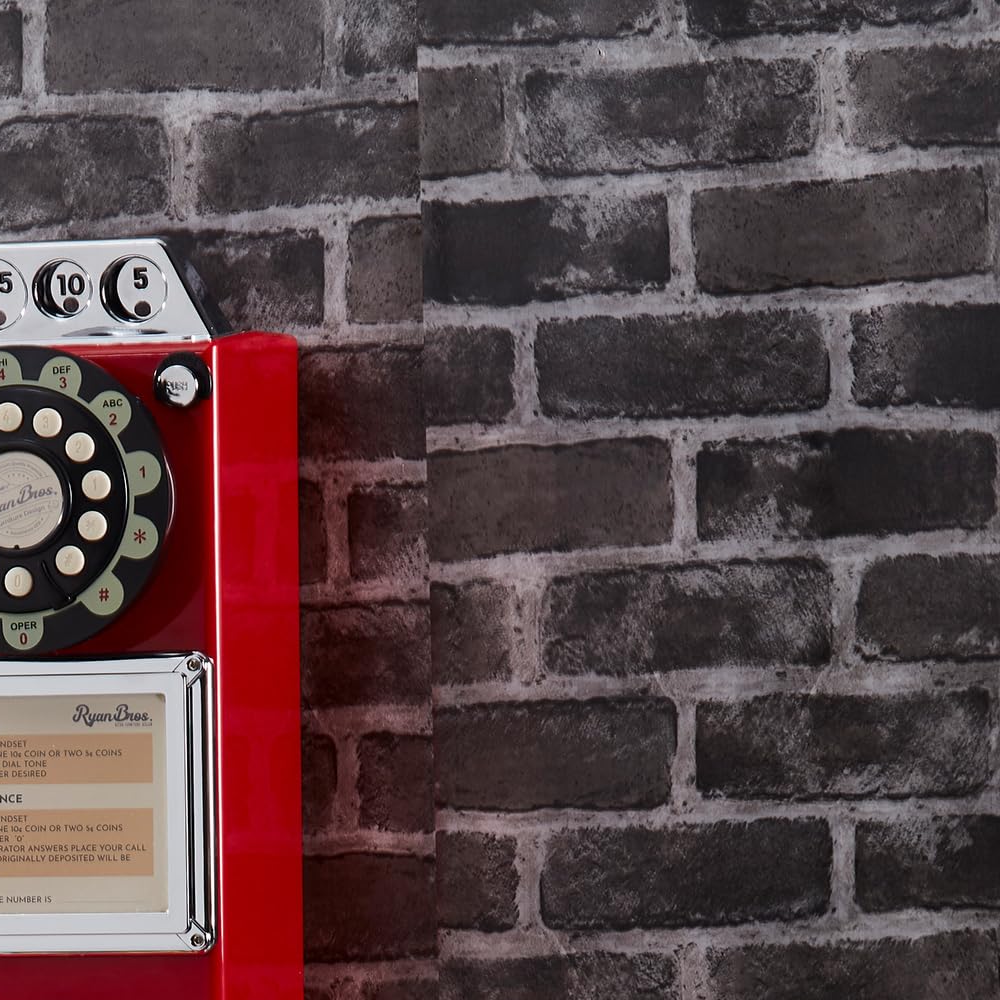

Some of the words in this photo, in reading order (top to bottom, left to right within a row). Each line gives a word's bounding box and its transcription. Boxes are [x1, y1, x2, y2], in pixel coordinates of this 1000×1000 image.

[132, 266, 148, 289] 5
[56, 273, 85, 296] 10
[52, 365, 71, 374] DEF
[59, 376, 67, 388] 3
[102, 399, 123, 408] ABC
[109, 413, 117, 426] 2
[140, 466, 146, 478] 1
[99, 588, 110, 602] #
[10, 621, 37, 631] OPER
[20, 632, 28, 645] 0
